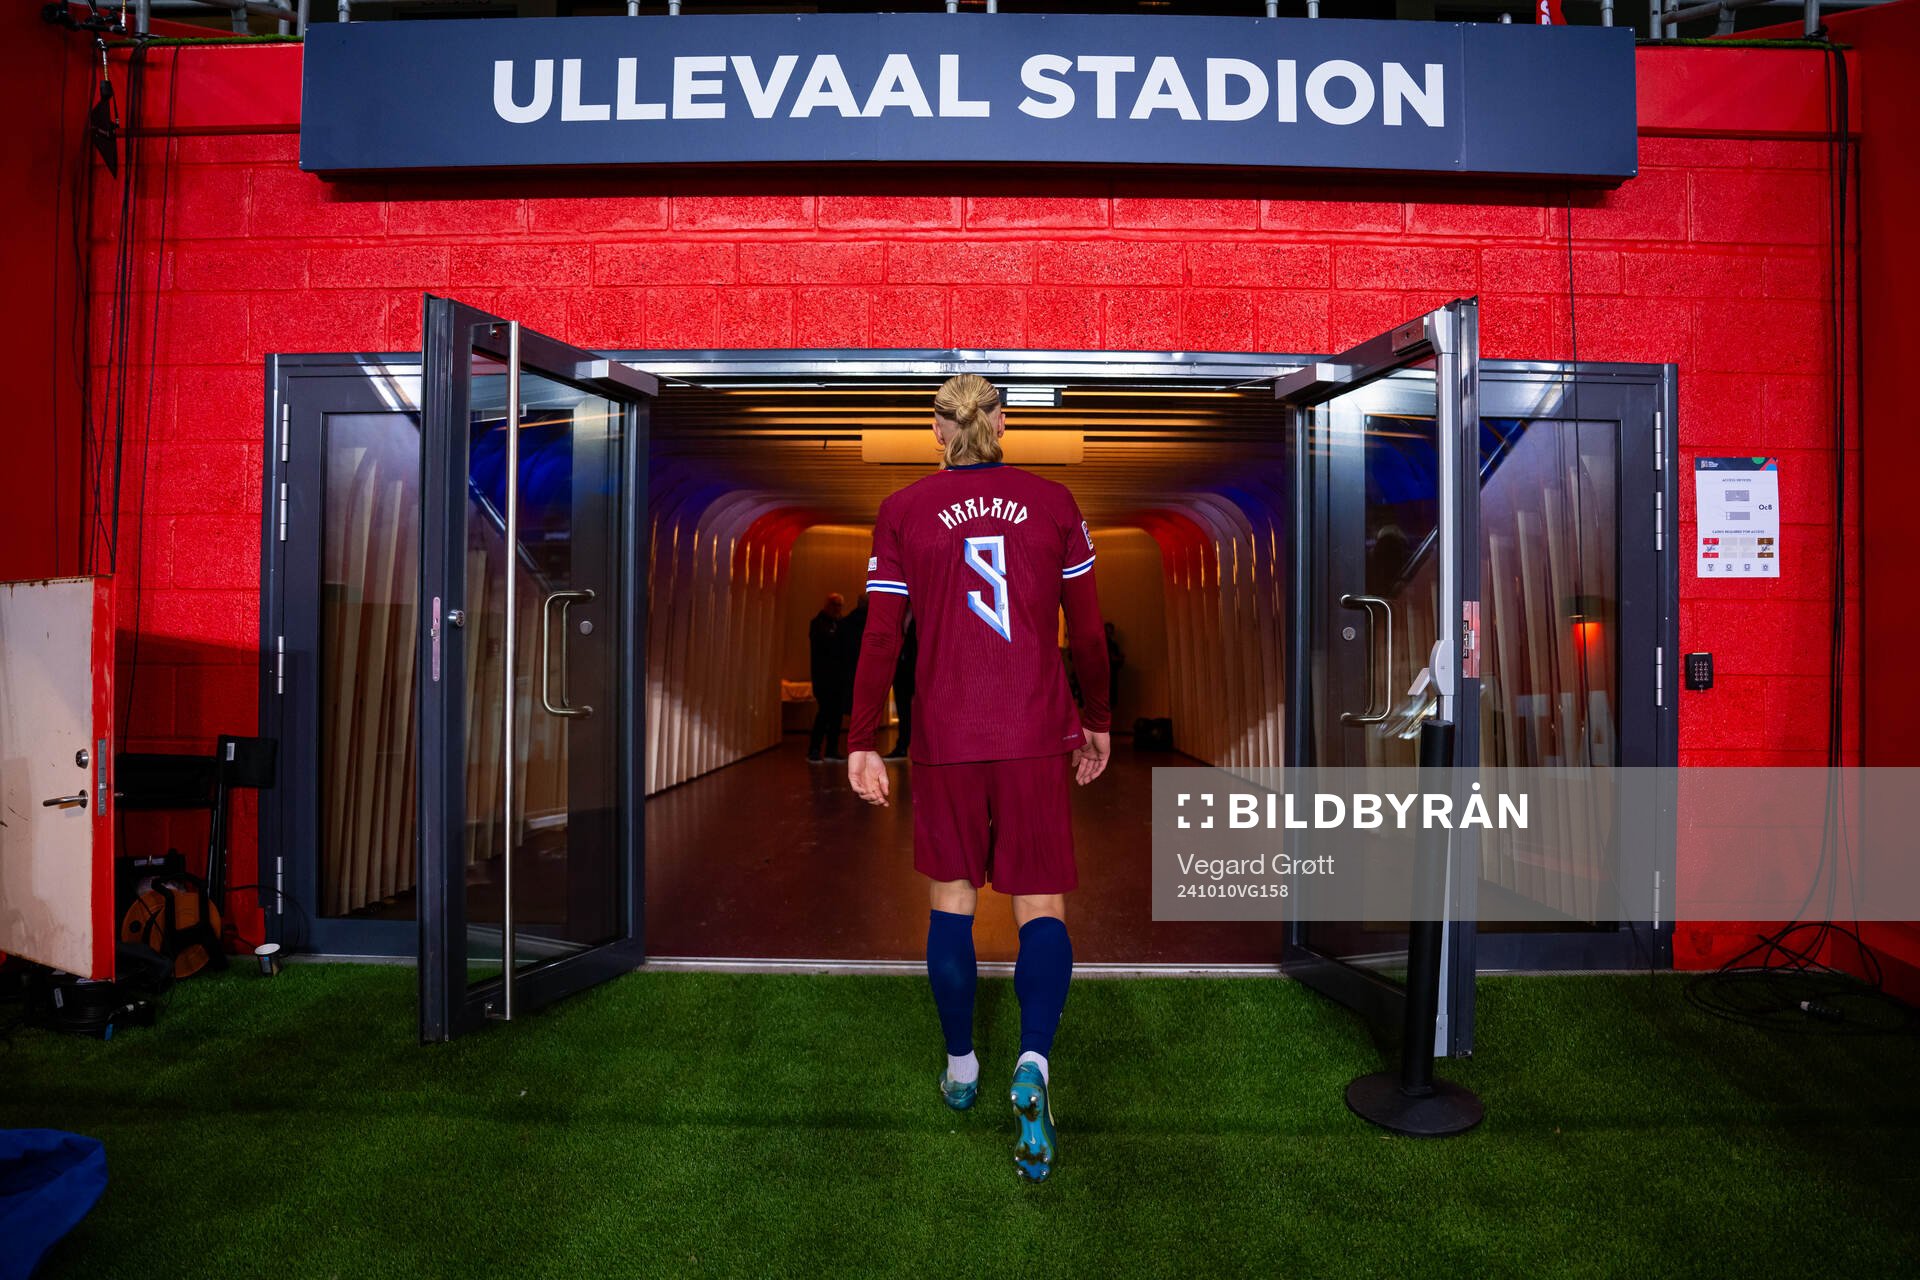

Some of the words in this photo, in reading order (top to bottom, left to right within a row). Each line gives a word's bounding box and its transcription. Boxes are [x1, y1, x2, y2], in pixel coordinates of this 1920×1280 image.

[493, 53, 991, 124] ULLEVAAL
[1018, 54, 1446, 128] STADION
[937, 496, 1028, 530] HAALAND
[964, 535, 1012, 643] 9
